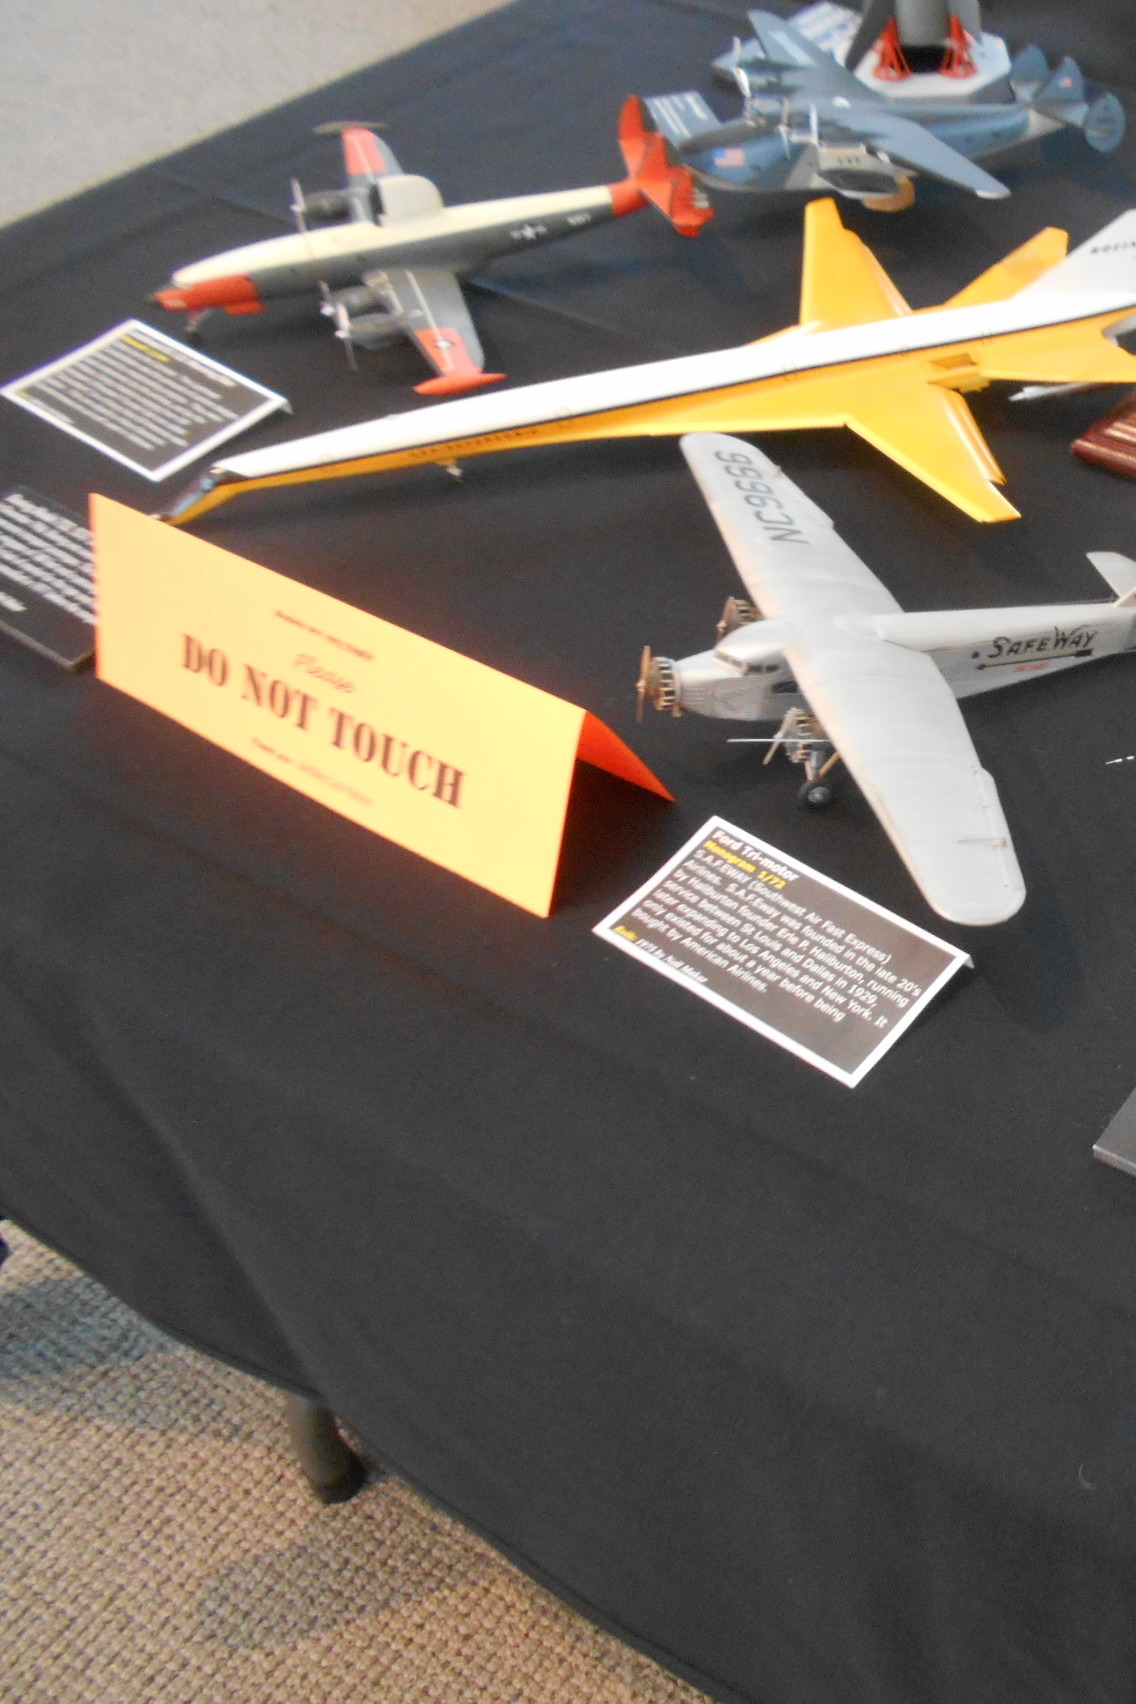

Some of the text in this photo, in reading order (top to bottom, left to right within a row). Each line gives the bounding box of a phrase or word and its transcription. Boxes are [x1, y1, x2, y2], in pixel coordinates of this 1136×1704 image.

[184, 635, 229, 686] DO
[244, 666, 314, 729] NOT
[332, 710, 462, 806] TOUCH
[295, 654, 354, 693] Please
[703, 840, 786, 889] Monogram 1/72
[712, 830, 798, 881] Ford Tri-motor
[632, 907, 767, 992] bought by American Airlines.
[642, 899, 666, 916] only
[664, 912, 702, 936] existed
[700, 931, 718, 945] for
[716, 942, 748, 963] about
[754, 965, 780, 982] year
[779, 978, 815, 1003] before
[813, 998, 846, 1022] being
[653, 888, 888, 1028] later expanding to Los Angeles and New York. It
[663, 880, 877, 1008] service between St Louis and Dallas in 1929,
[673, 868, 689, 882] by
[737, 905, 777, 931] founder
[798, 939, 810, 951] P.
[867, 980, 909, 1008] running
[683, 860, 721, 885] Airlines.
[780, 915, 802, 930] was
[801, 925, 845, 953] founded
[843, 949, 856, 960] in
[855, 956, 875, 972] the
[875, 966, 897, 983] late
[896, 978, 922, 997] 20's
[748, 880, 806, 916] (Southwest
[804, 912, 822, 924] Air
[821, 920, 845, 938] Fast
[844, 933, 891, 965] Express)
